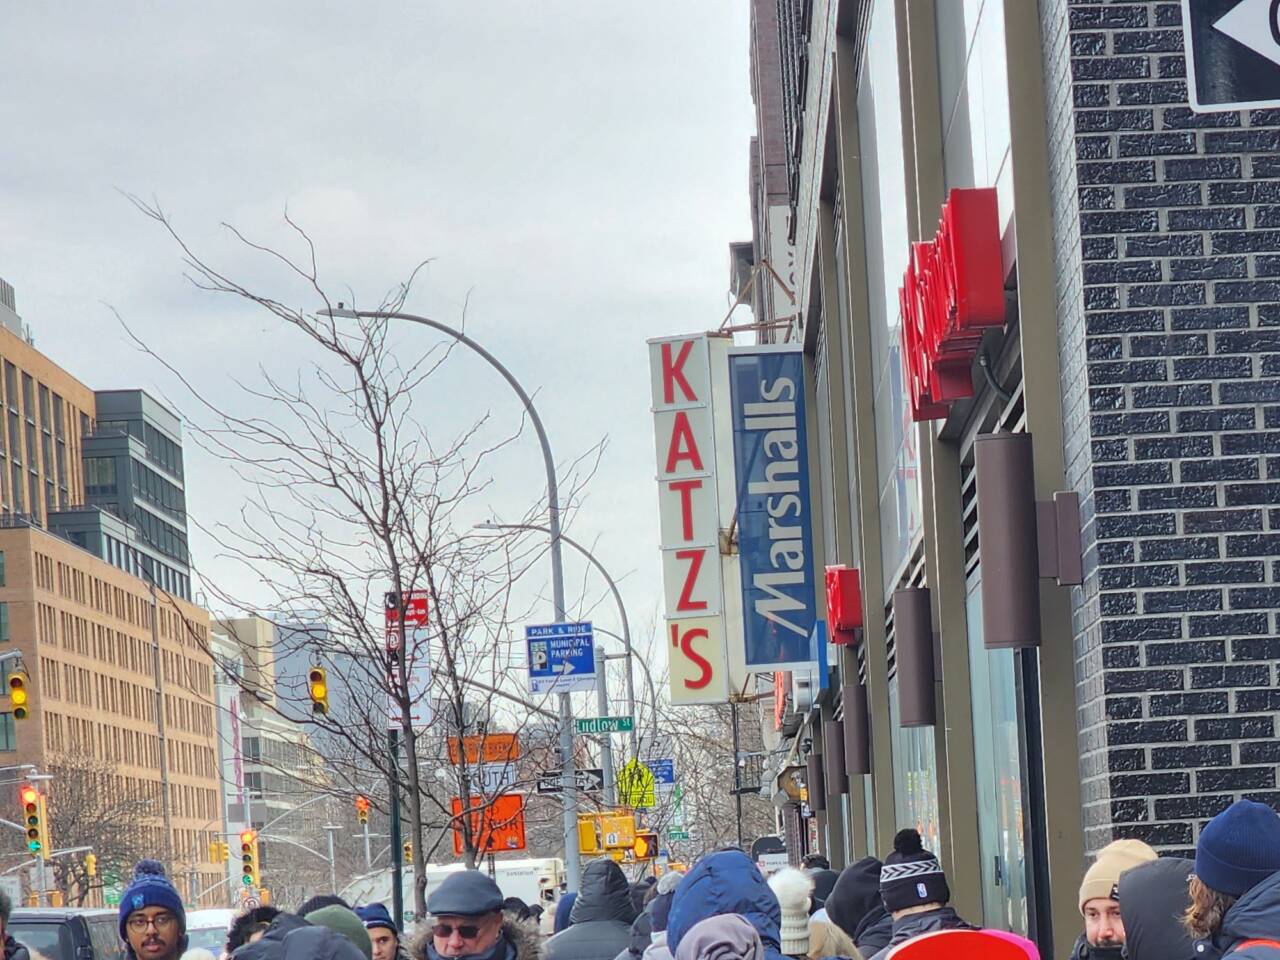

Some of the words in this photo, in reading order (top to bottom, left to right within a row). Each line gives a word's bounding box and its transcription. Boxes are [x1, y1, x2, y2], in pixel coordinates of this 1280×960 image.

[660, 340, 713, 690] KATZ'S
[743, 376, 808, 638] Marshalls
[577, 719, 619, 733] Ludlow
